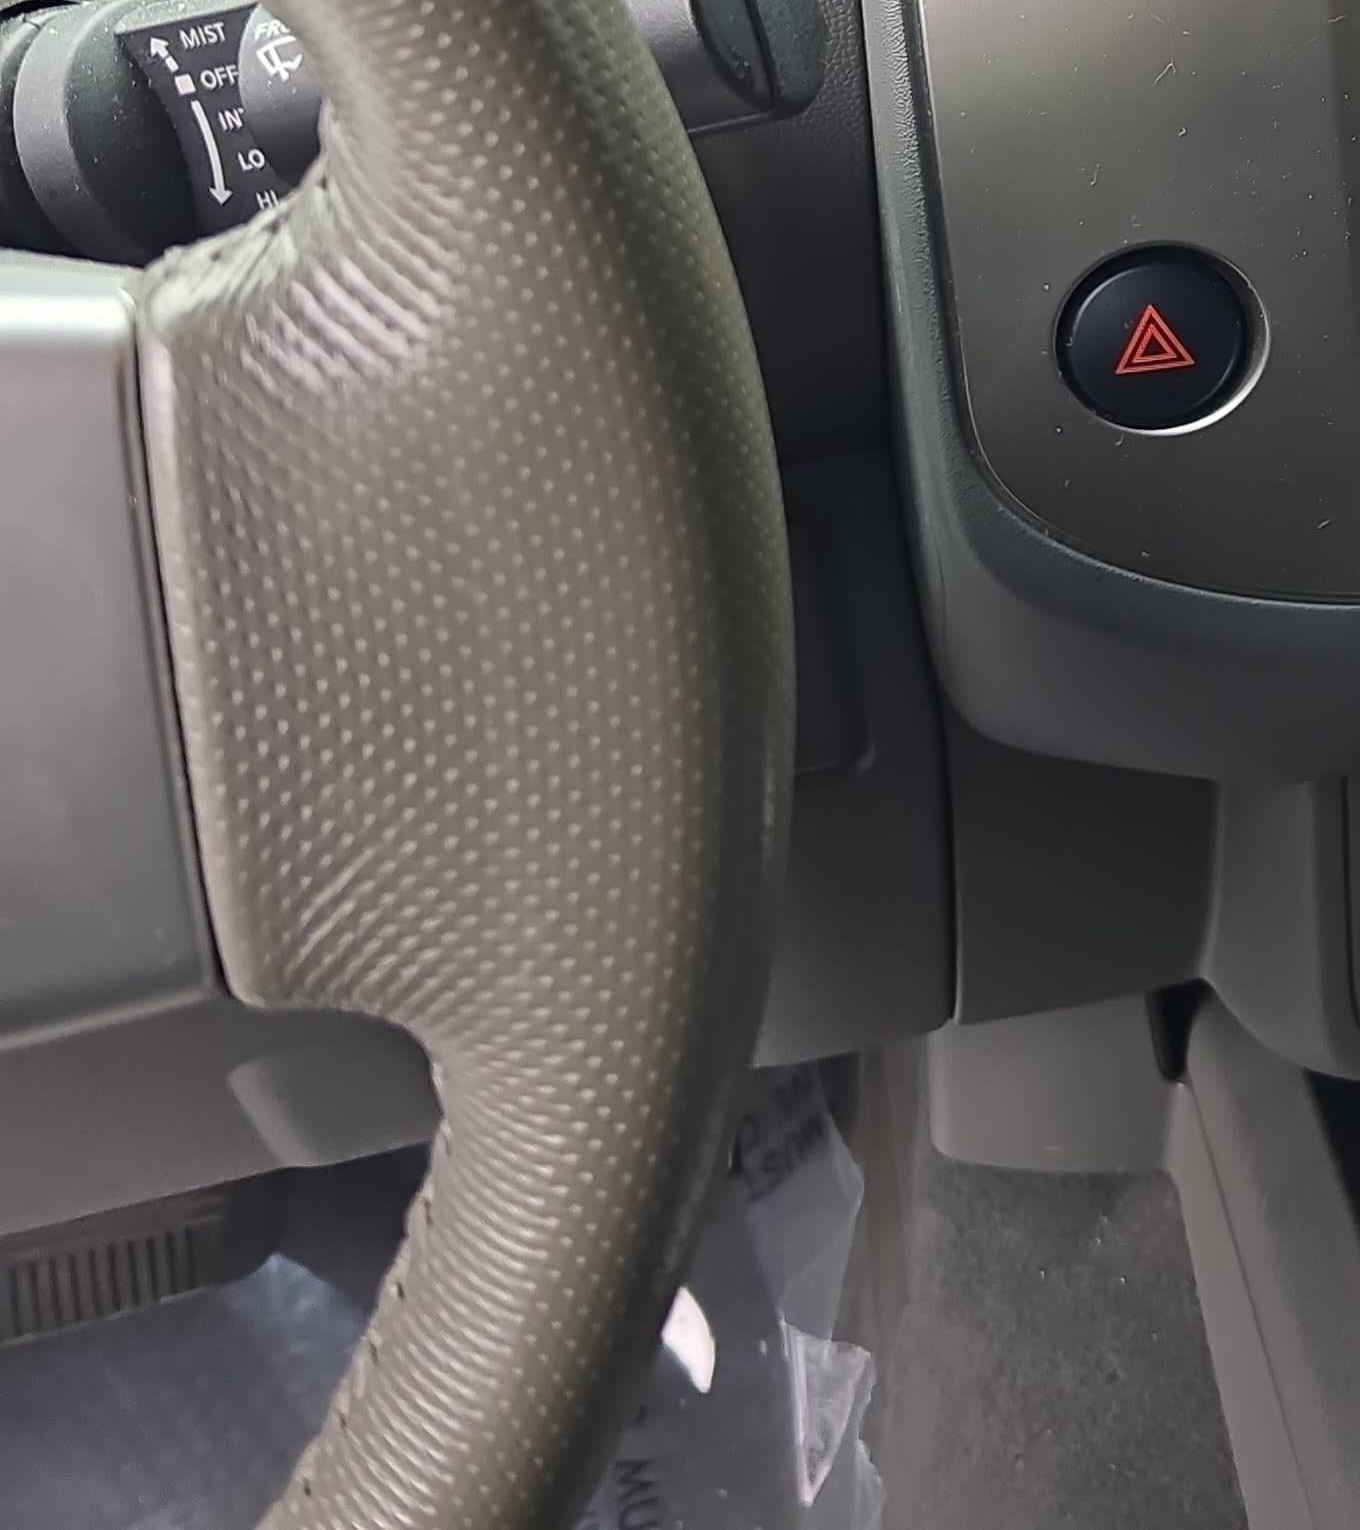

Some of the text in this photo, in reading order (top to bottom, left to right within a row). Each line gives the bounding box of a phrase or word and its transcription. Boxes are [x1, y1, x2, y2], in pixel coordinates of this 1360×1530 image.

[179, 21, 226, 50] MIST
[200, 64, 240, 90] OFF
[236, 148, 266, 171] LO
[255, 189, 279, 210] HI
